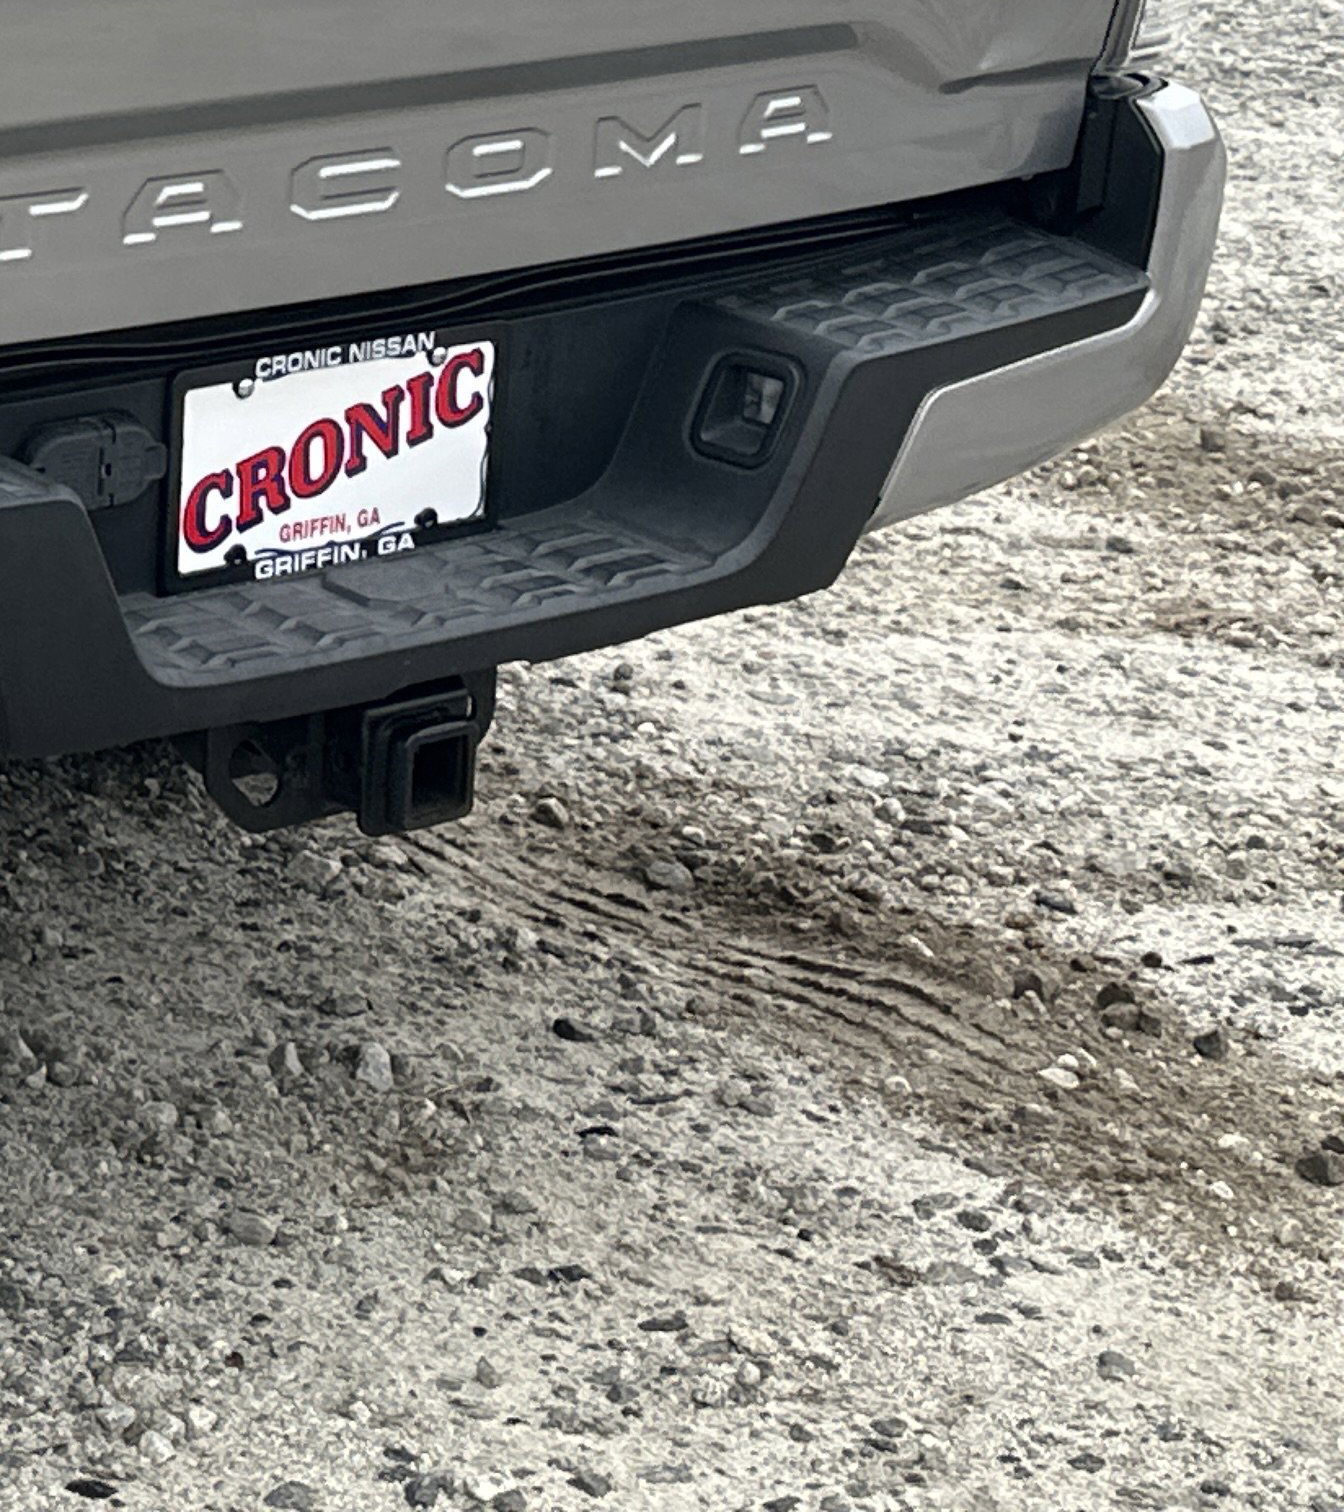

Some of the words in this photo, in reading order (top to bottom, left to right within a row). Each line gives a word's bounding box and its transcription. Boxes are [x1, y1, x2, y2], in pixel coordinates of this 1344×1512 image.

[255, 346, 342, 378] CRONIC
[348, 330, 436, 363] NISSAN
[183, 347, 485, 555] CRONIC
[279, 513, 352, 544] GRIFFIN,
[356, 506, 381, 528] GA
[377, 532, 416, 556] GA
